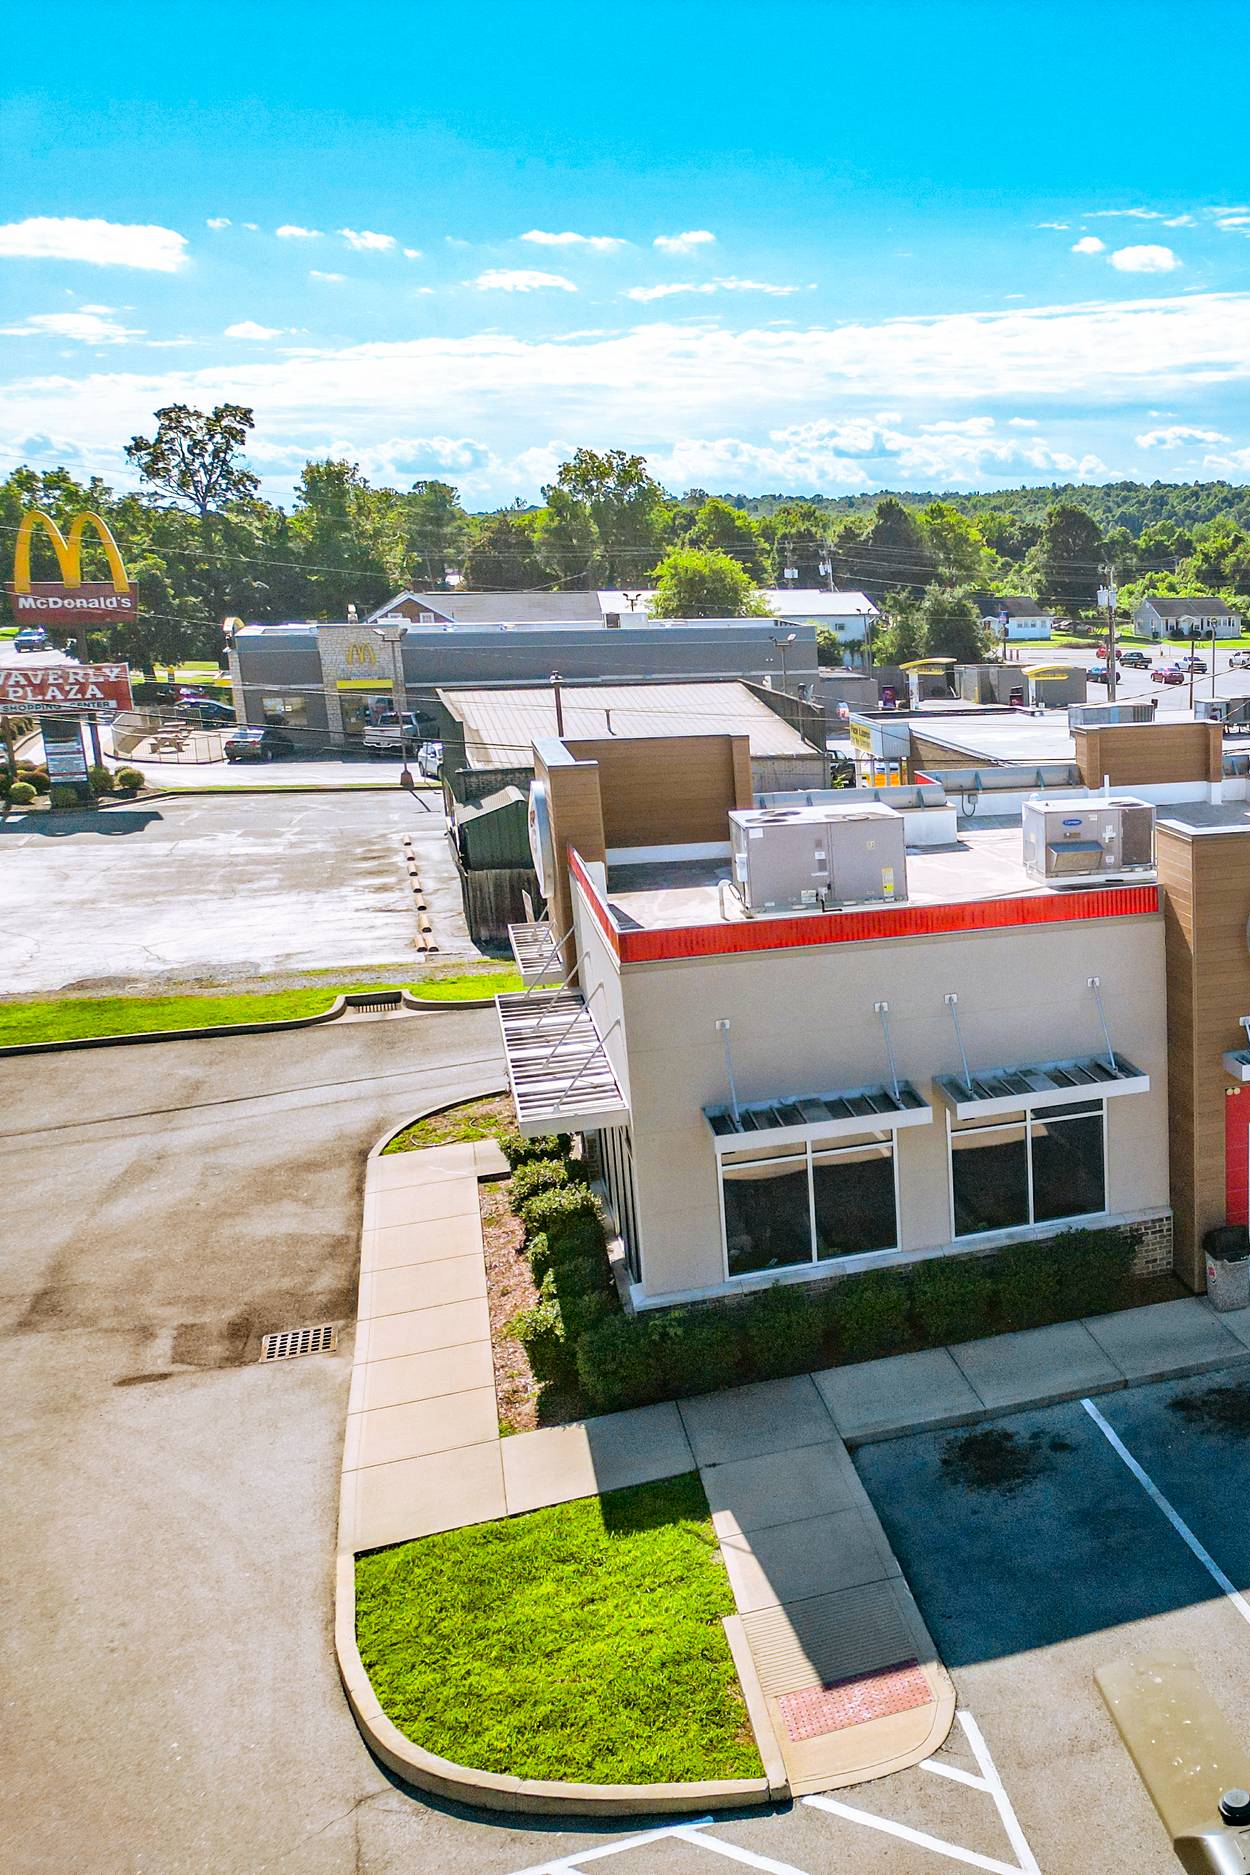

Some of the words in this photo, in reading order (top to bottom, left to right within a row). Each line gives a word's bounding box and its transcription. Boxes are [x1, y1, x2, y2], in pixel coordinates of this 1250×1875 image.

[18, 596, 132, 609] McDonald's
[6, 684, 104, 701] PLAZA
[2, 702, 61, 712] SHOPPING
